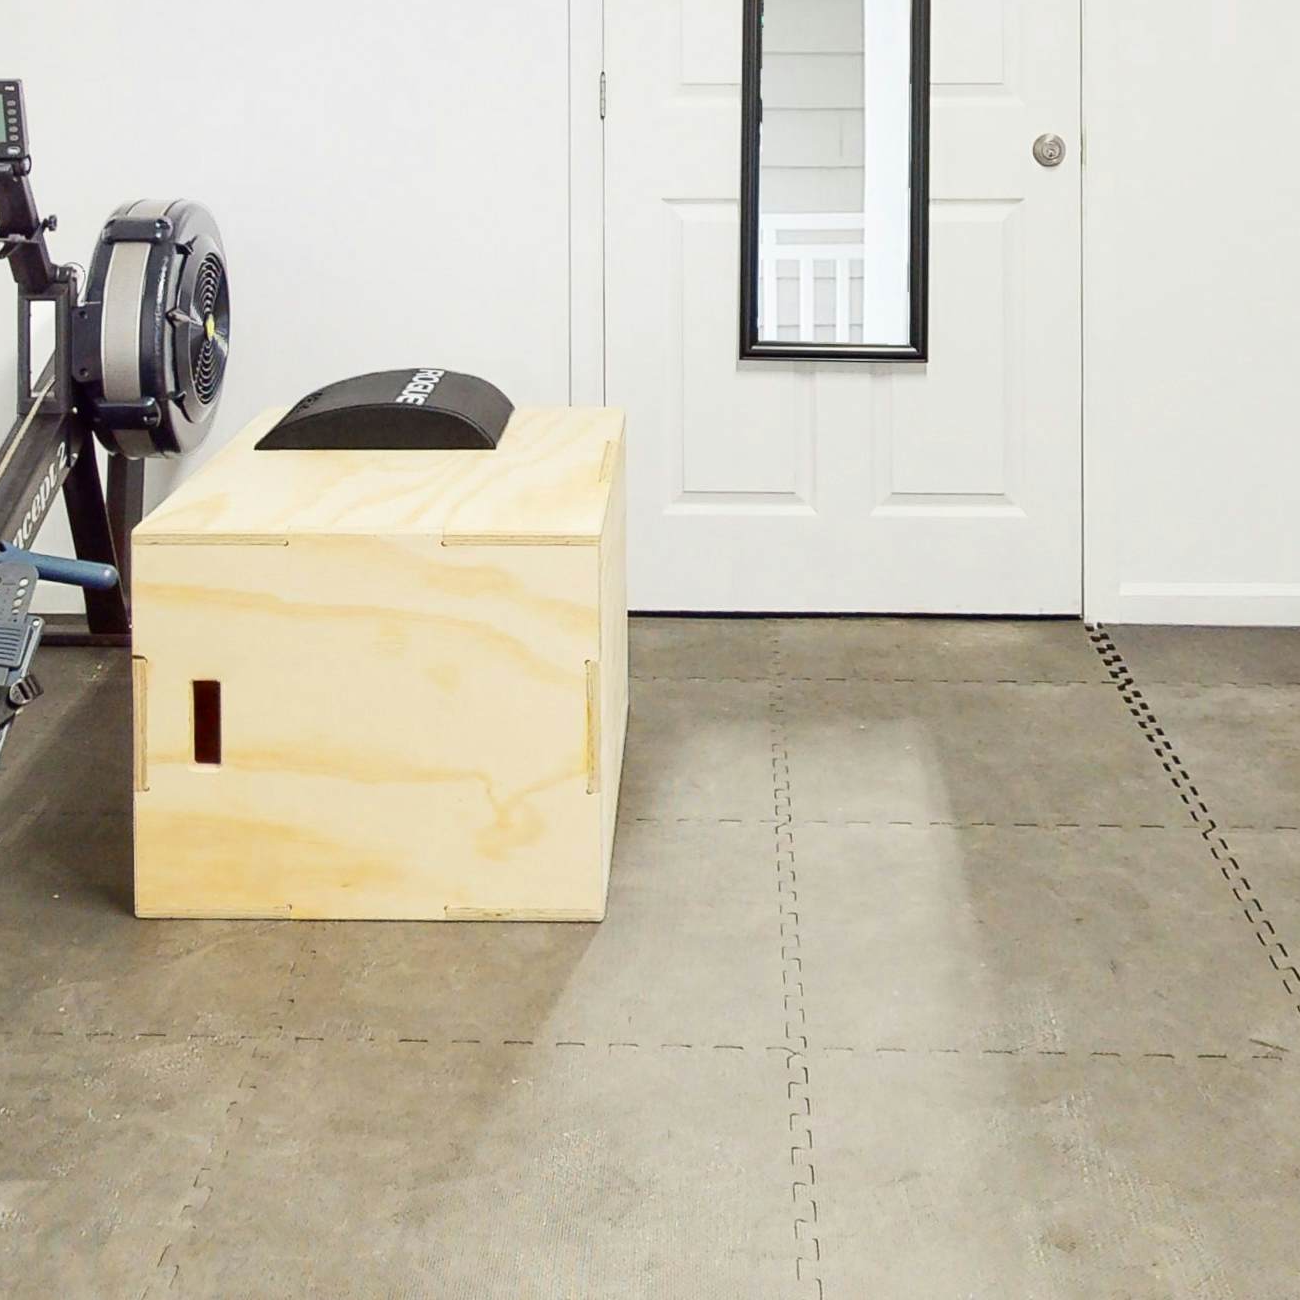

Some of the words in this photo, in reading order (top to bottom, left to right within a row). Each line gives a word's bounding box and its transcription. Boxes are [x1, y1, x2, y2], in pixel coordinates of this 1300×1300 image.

[395, 369, 445, 406] ROGUE
[12, 462, 58, 550] ncept
[57, 441, 68, 475] 2
